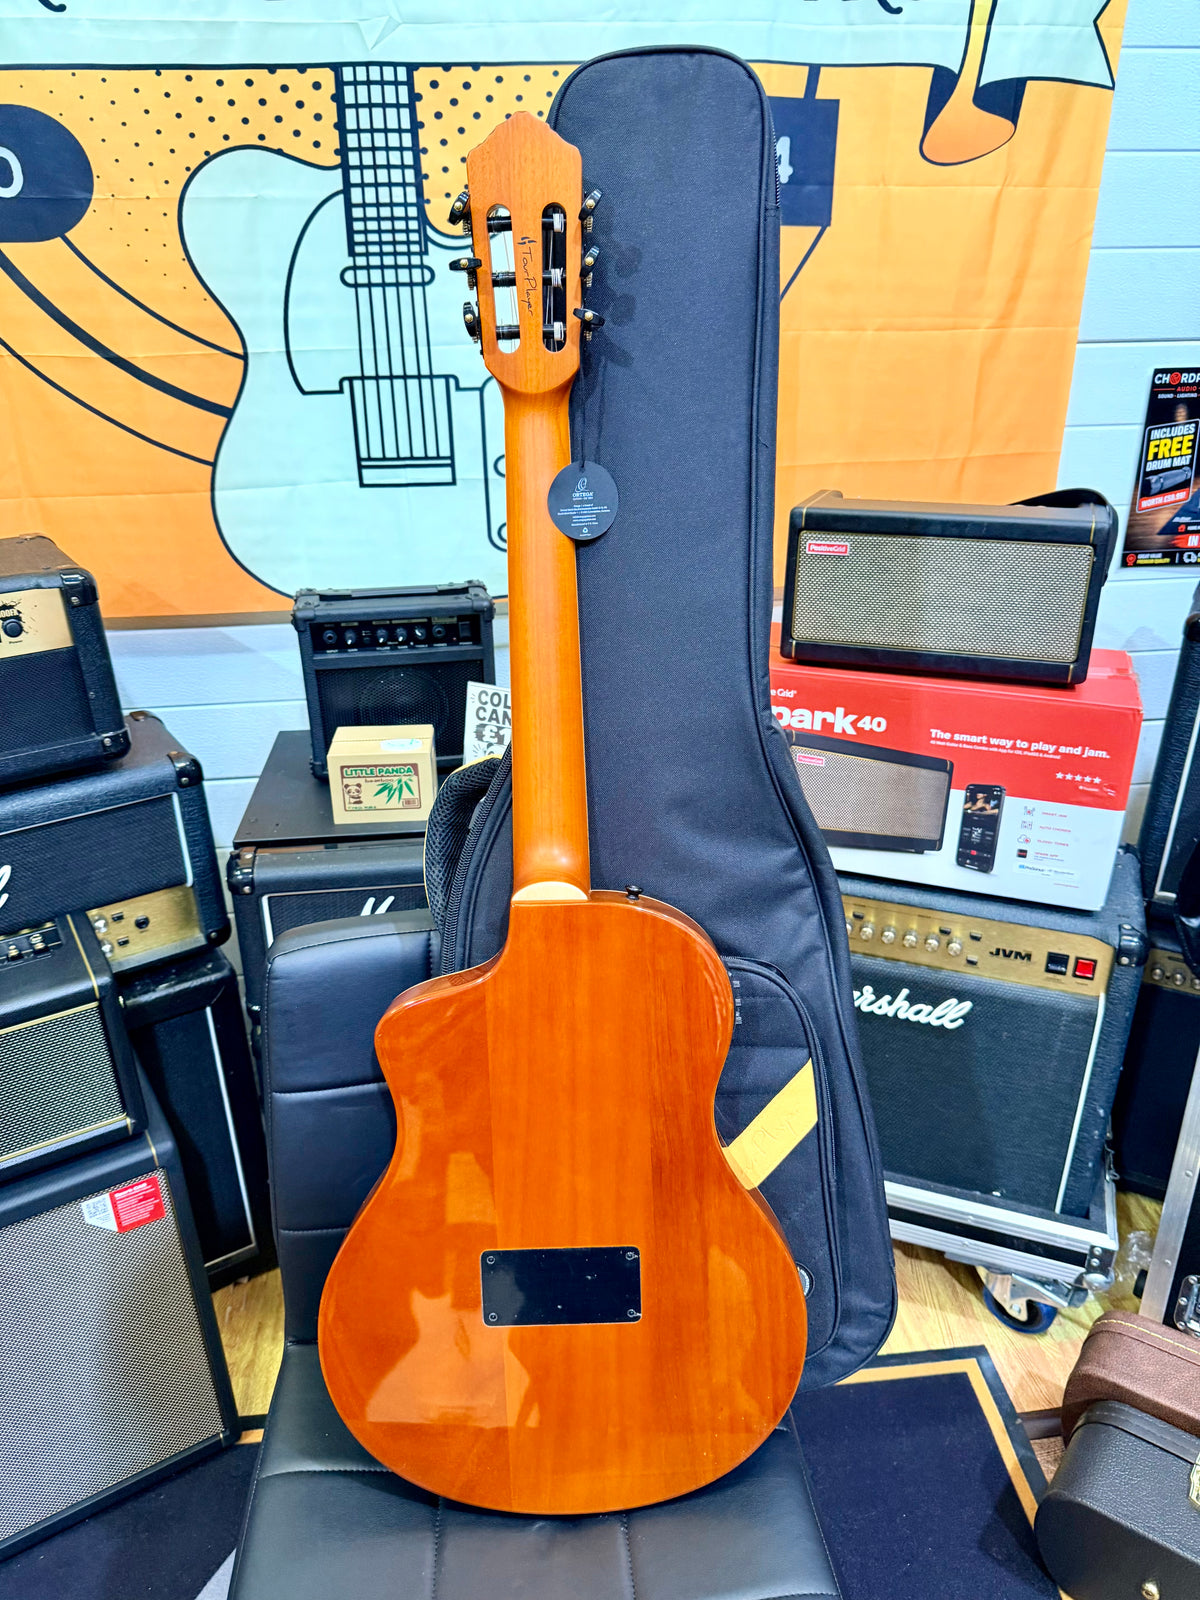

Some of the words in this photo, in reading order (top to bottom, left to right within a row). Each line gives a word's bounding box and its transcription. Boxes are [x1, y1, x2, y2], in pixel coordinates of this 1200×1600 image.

[1150, 423, 1196, 440] INCLUDES
[1147, 434, 1194, 461] FREE
[1145, 458, 1172, 472] DRUM
[1172, 455, 1192, 467] MAT
[1141, 495, 1164, 508] WORTH
[1187, 535, 1200, 547] IN
[478, 690, 512, 710] COL
[475, 706, 512, 726] CAN
[771, 705, 858, 735] park
[857, 715, 887, 732] 40
[930, 728, 952, 740] The
[953, 733, 988, 745] smart
[989, 737, 1014, 749] way
[1015, 739, 1029, 749] to
[1030, 741, 1057, 754] play
[1058, 744, 1082, 755] and
[1082, 746, 1111, 759] jam.
[344, 767, 376, 777] LITTLE
[377, 766, 414, 776] PANDA
[989, 947, 1032, 963] JVM
[853, 985, 974, 1030] rshall
